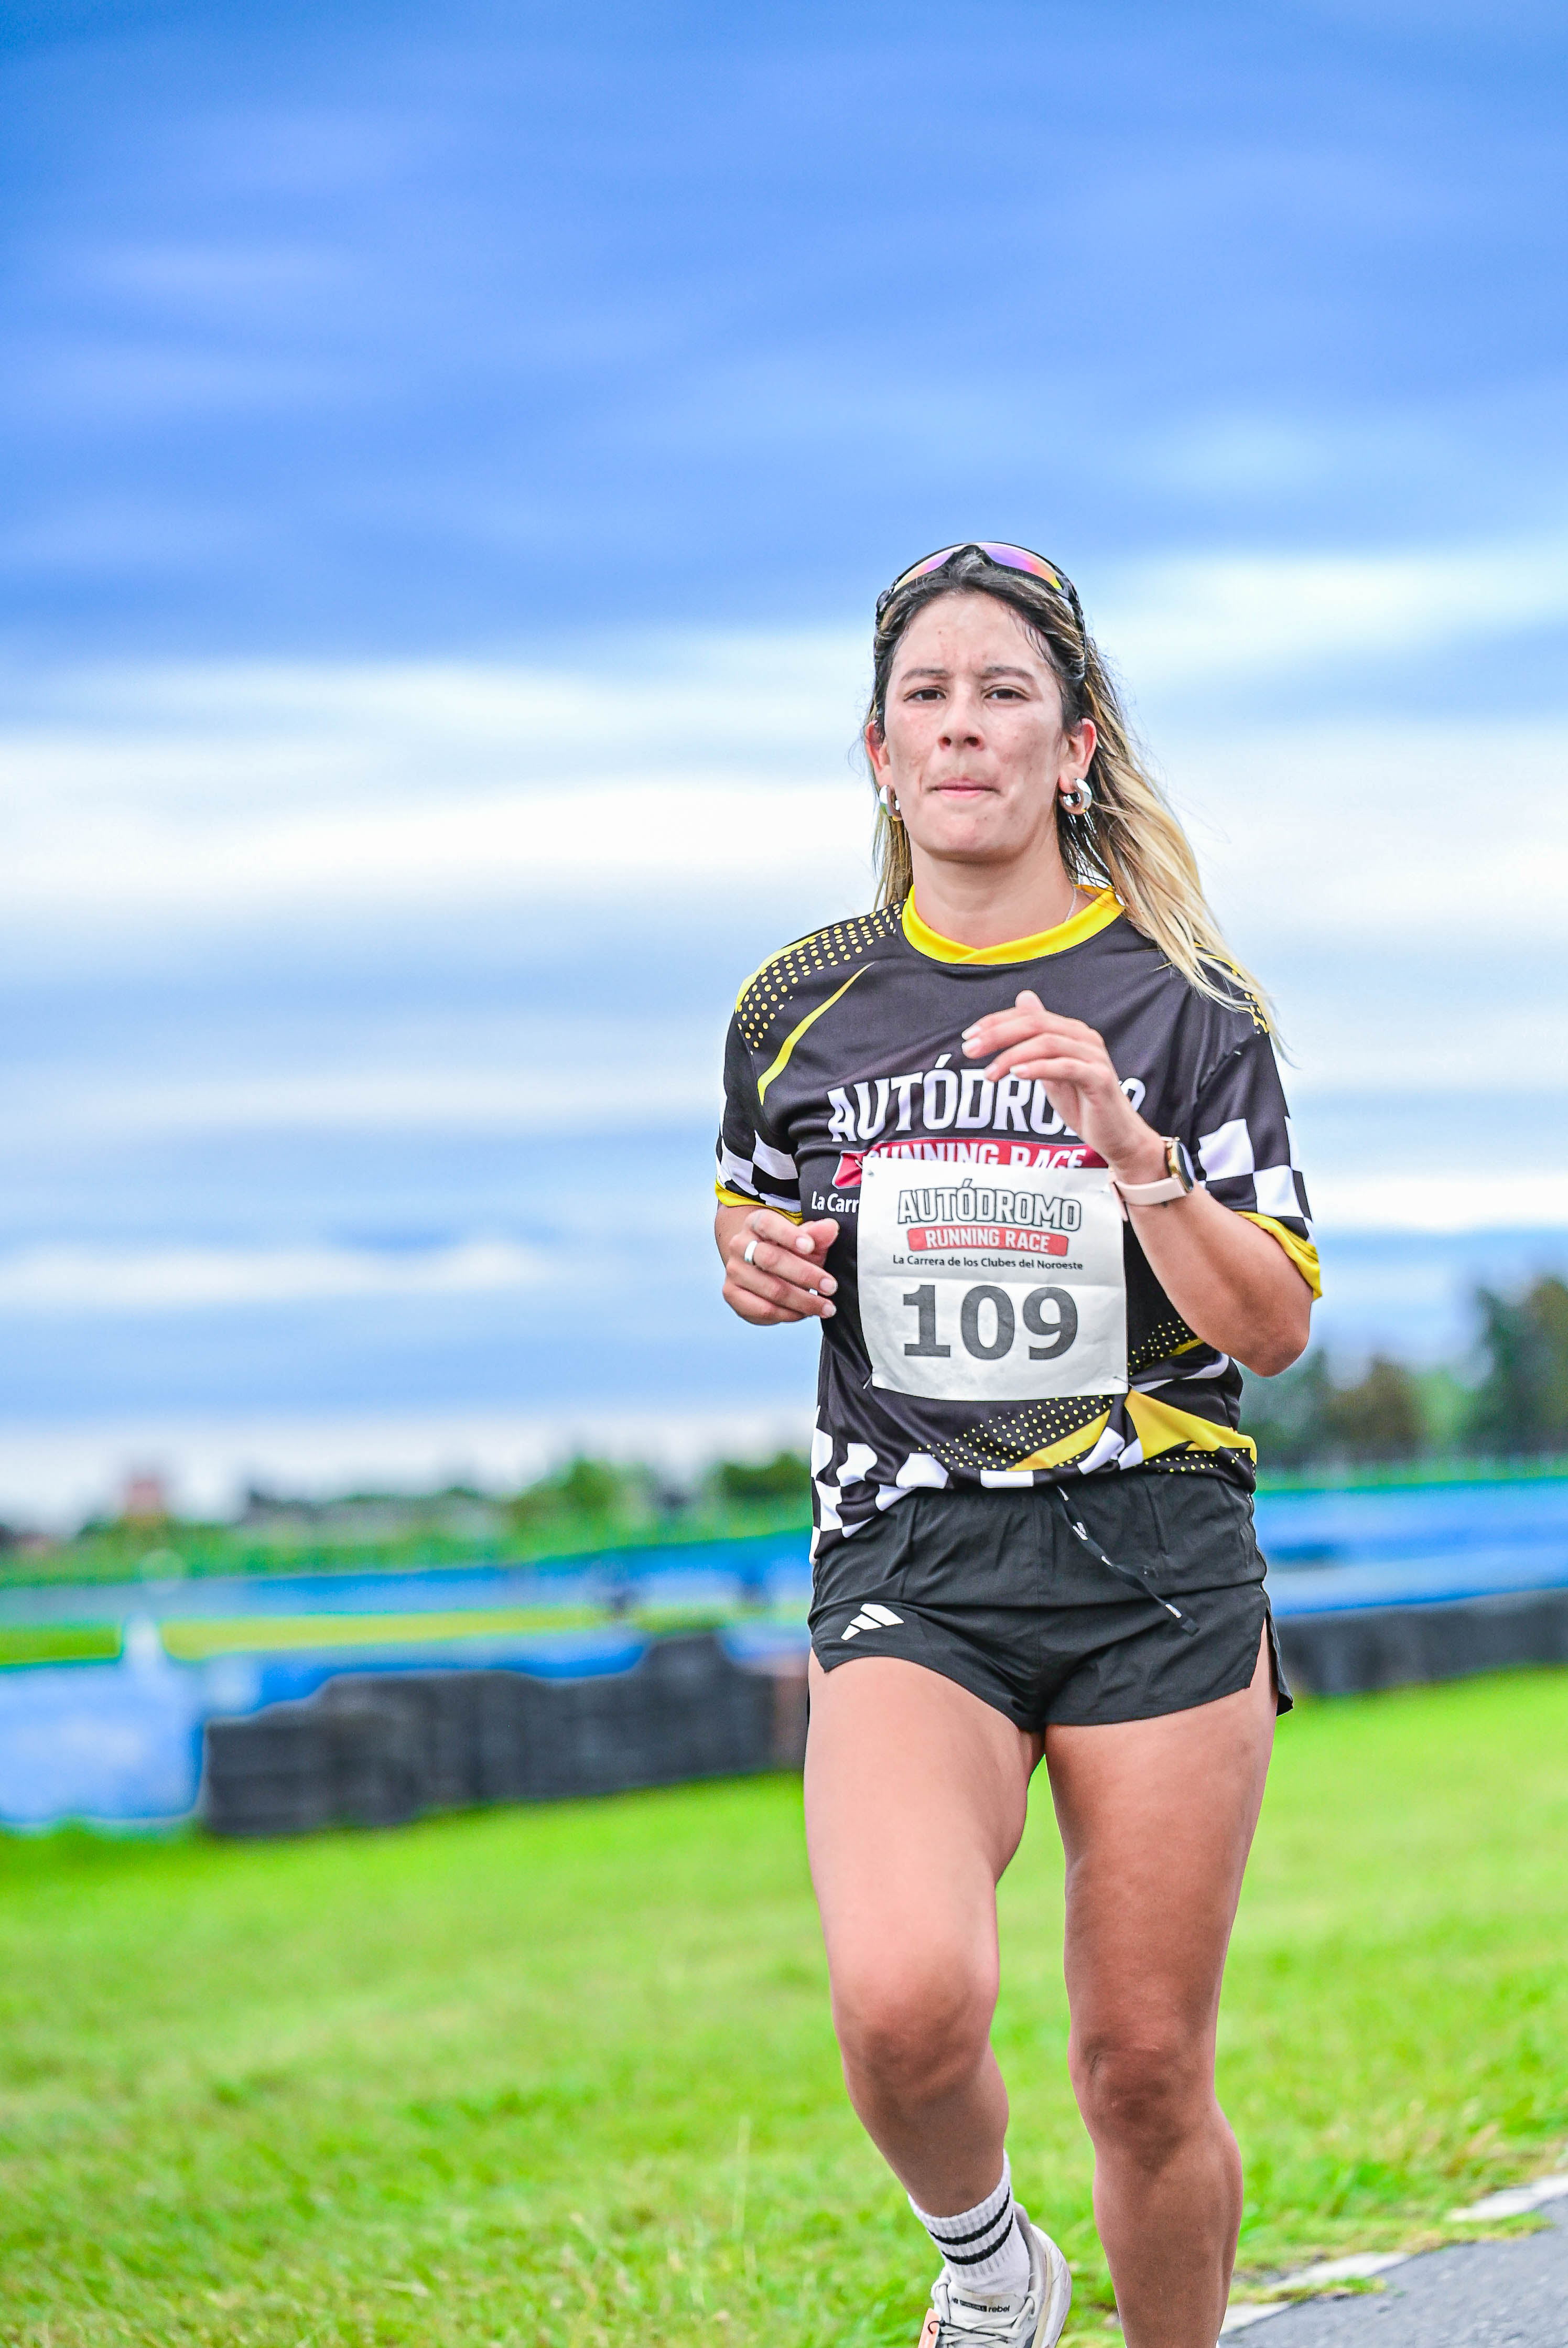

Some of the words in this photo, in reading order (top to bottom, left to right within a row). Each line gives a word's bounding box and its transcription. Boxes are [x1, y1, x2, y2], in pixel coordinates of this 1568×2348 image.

[827, 1054, 1147, 1142] AUTÓDRO
[812, 1191, 825, 1210] La
[827, 1193, 859, 1213] Carr
[897, 1178, 1082, 1231] AUTÓDROMO
[925, 1229, 1000, 1248] RUNNING
[1005, 1230, 1051, 1252] RACE
[893, 1255, 904, 1264] La
[907, 1256, 944, 1266] Carrera
[948, 1257, 960, 1266] de
[964, 1257, 978, 1267] los
[981, 1258, 1015, 1267] Clubes
[1019, 1259, 1034, 1268] del
[1037, 1260, 1083, 1270] Noroeste
[903, 1285, 1078, 1361] 109
